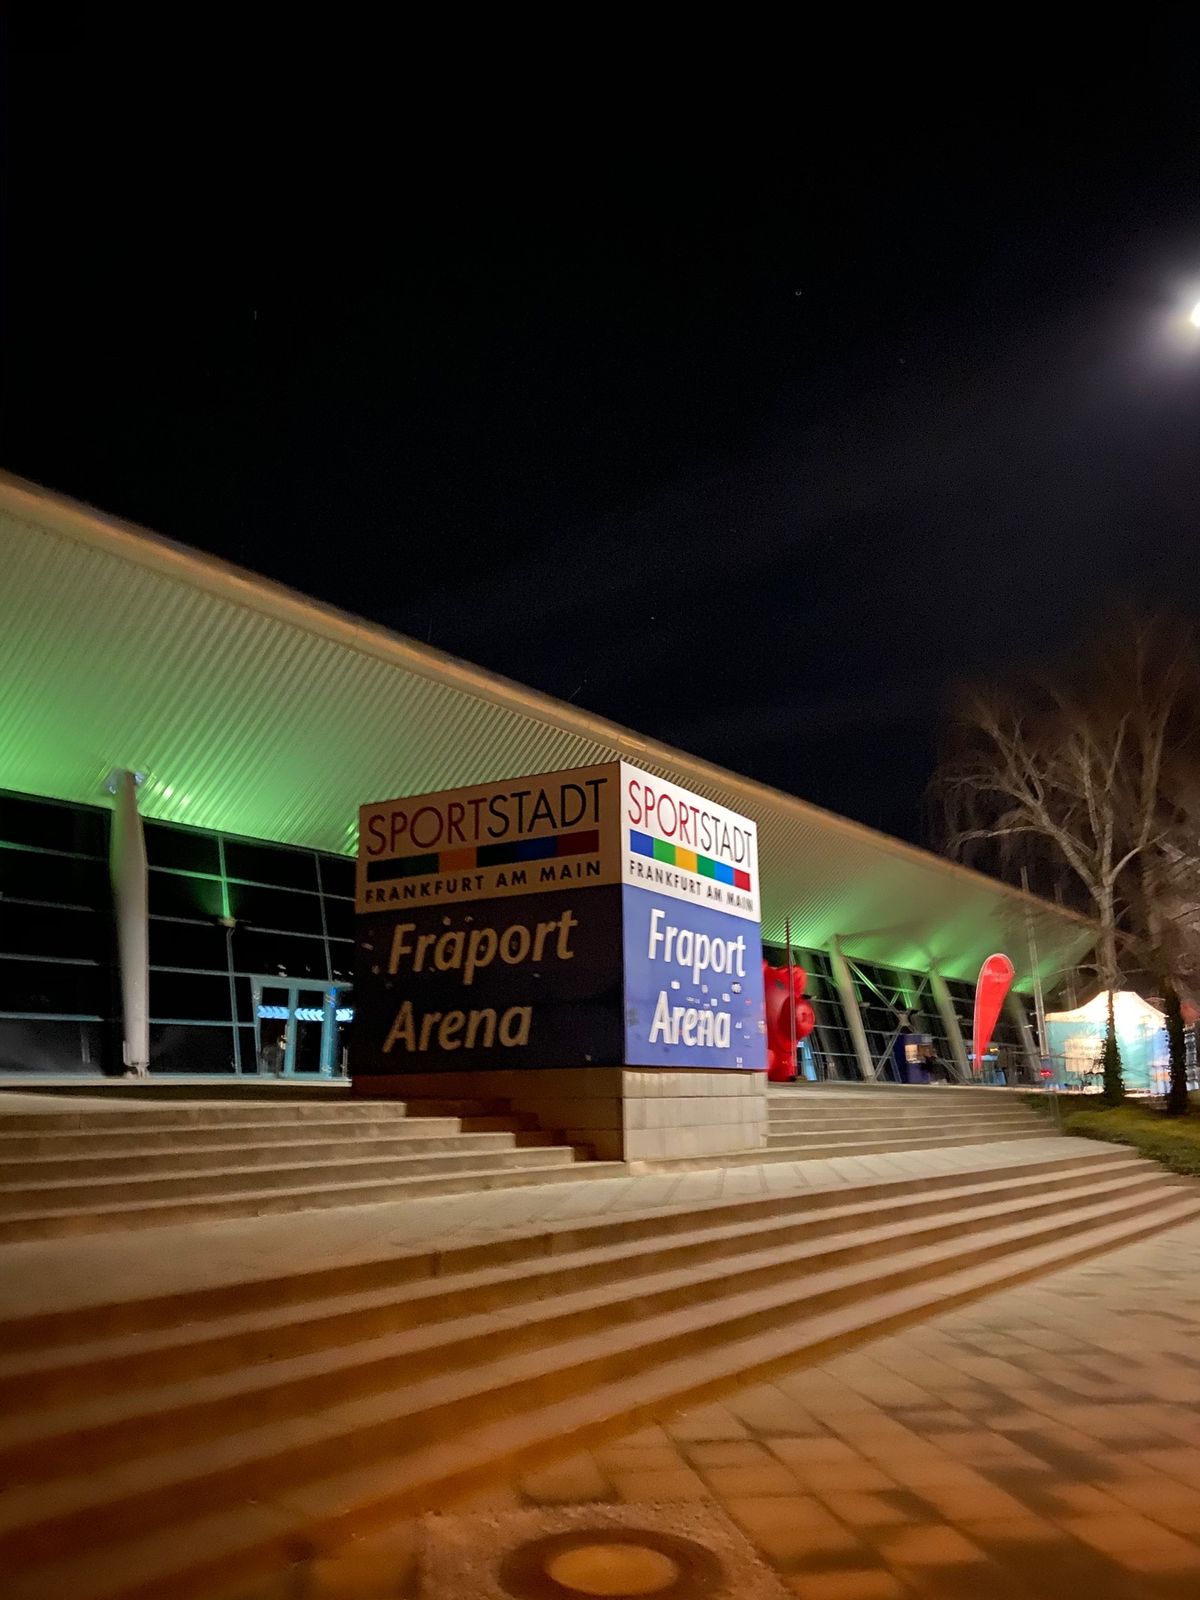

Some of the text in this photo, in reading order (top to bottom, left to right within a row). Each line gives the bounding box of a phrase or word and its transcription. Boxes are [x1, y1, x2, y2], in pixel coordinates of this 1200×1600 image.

[367, 779, 607, 855] SPORTSTADT
[628, 780, 752, 867] SPORTSTADT
[366, 860, 600, 903] FRANKFURT AM MAIN
[629, 860, 753, 912] FRANKFURT AM MAIN
[389, 910, 577, 985] Fraport
[648, 908, 746, 984] Fraport
[382, 1000, 532, 1053] Arena
[648, 990, 731, 1048] Arena
